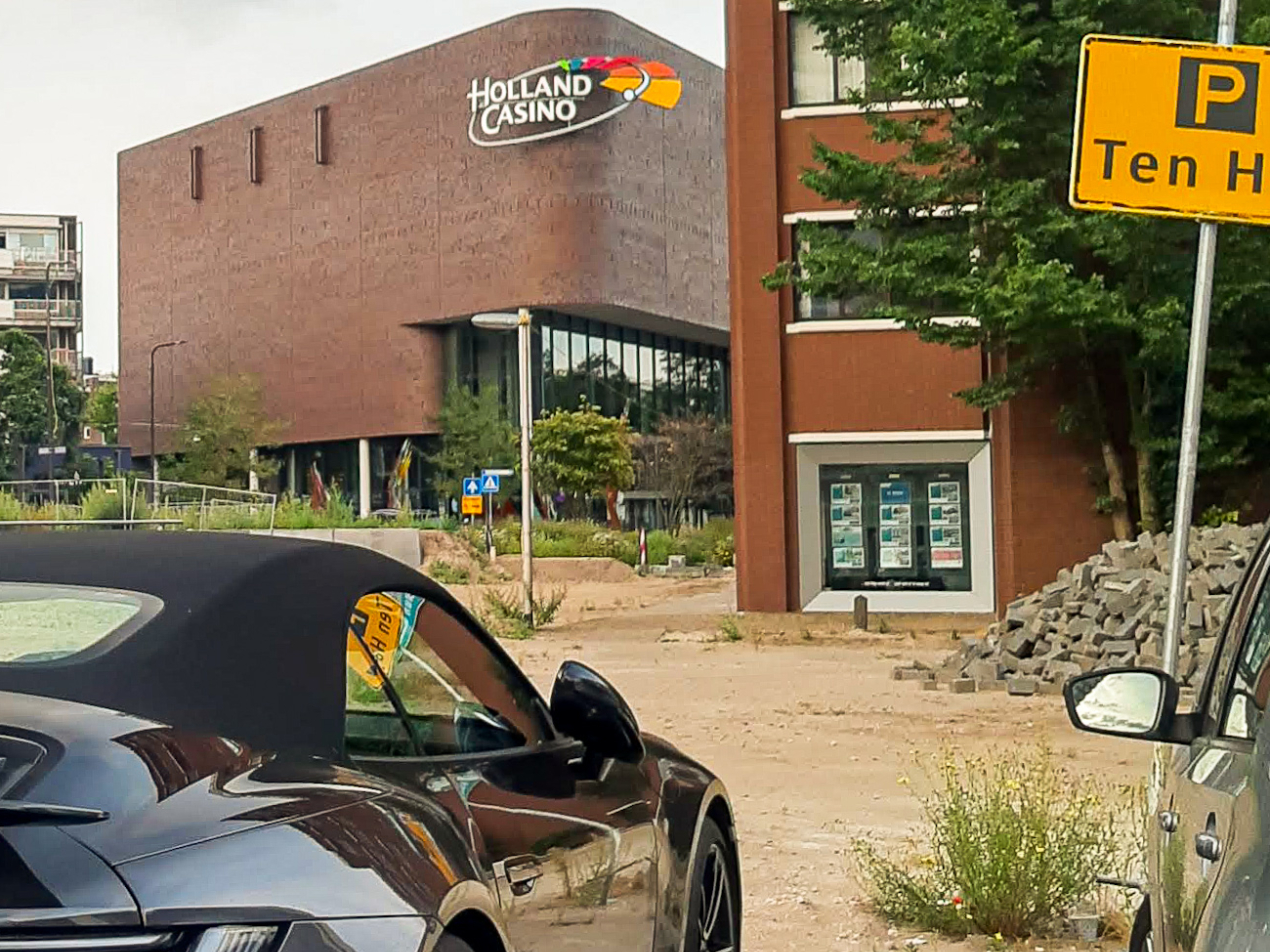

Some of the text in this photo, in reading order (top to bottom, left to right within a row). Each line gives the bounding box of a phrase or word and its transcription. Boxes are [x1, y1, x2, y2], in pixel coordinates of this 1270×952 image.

[467, 75, 592, 113] HOLLAND
[1194, 63, 1246, 124] P
[481, 99, 577, 135] CASINO
[1093, 138, 1198, 188] Ten
